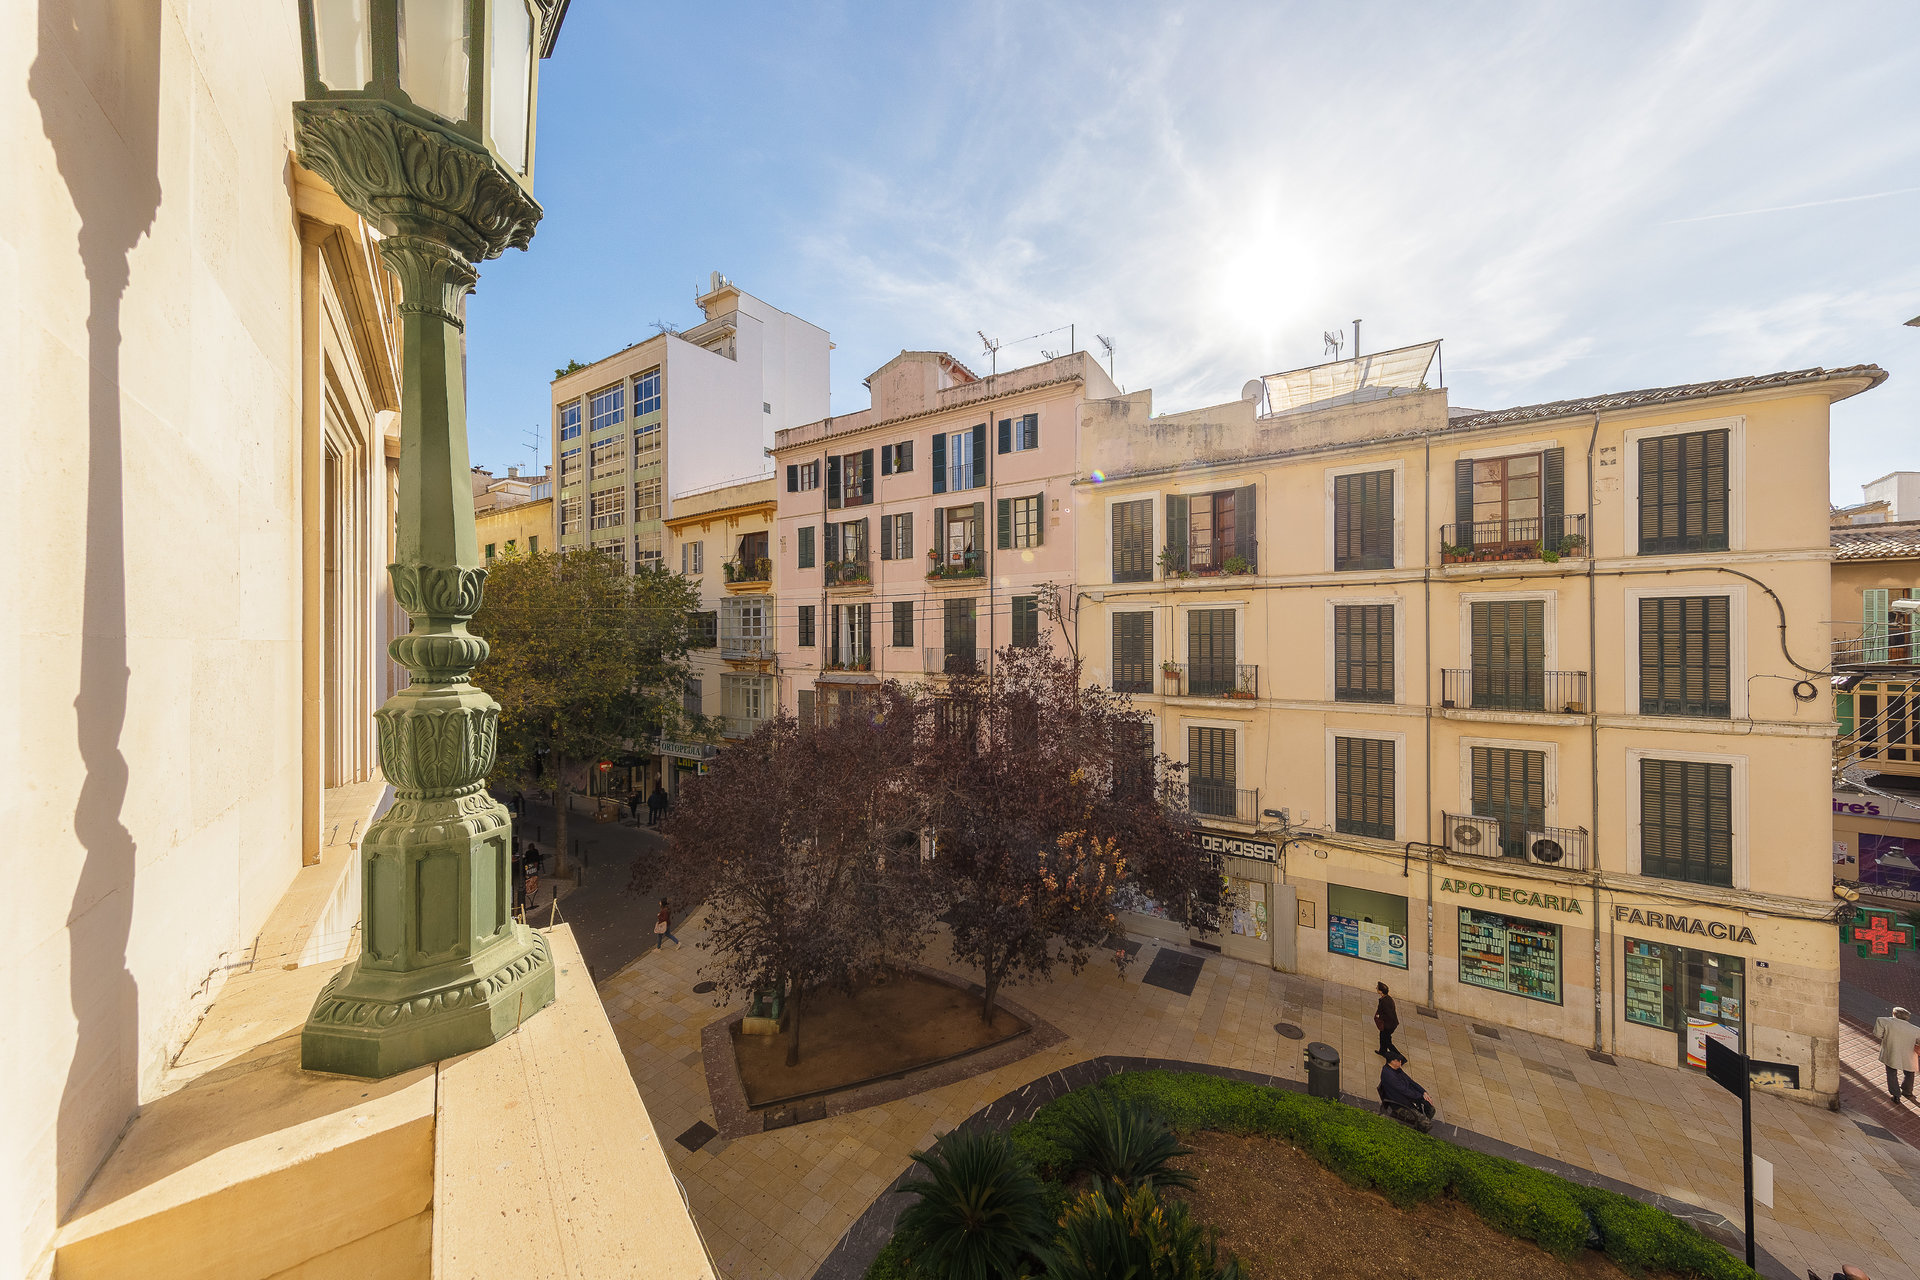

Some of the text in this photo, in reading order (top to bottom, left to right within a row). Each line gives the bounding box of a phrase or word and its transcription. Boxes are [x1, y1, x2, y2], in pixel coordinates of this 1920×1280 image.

[1832, 798, 1880, 815] ire's
[1200, 835, 1276, 861] DEMOSSA
[1440, 878, 1584, 915] APOTECARIA
[1615, 905, 1758, 945] FARMACIA
